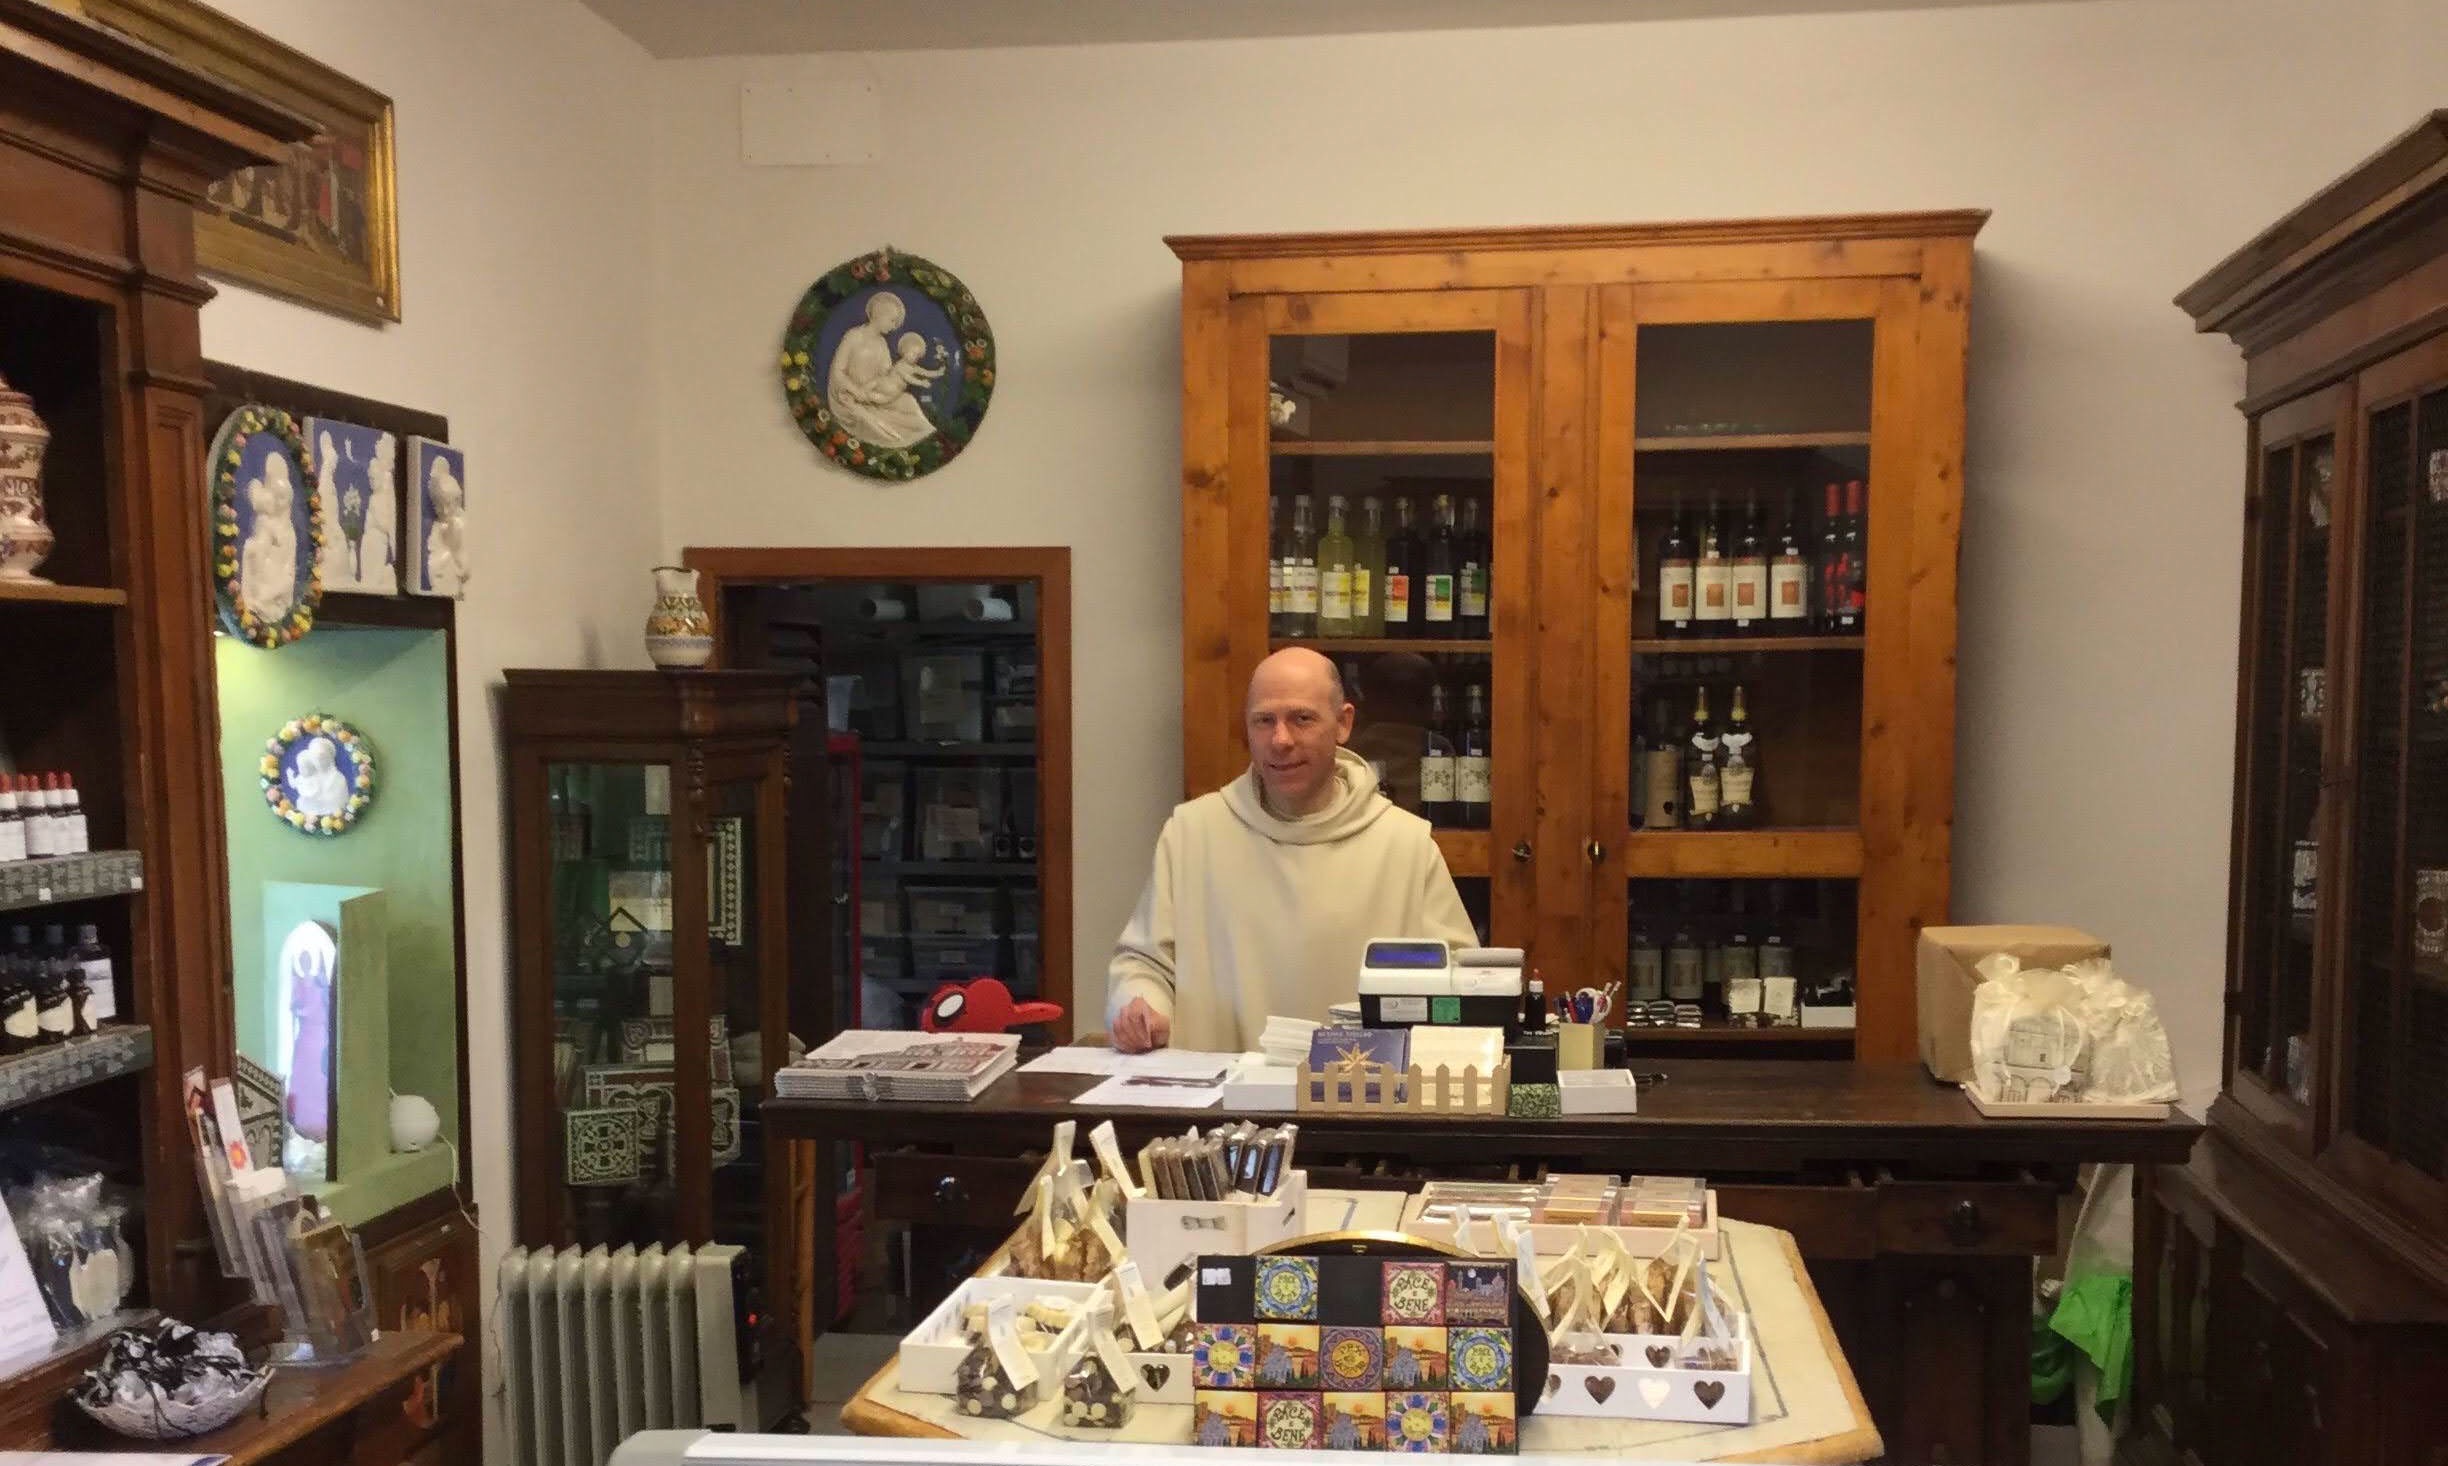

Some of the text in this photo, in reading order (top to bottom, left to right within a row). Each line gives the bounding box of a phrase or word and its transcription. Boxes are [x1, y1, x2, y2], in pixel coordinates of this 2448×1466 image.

[1396, 1275, 1430, 1291] PACE
[1394, 1296, 1430, 1312] BENE
[1273, 1404, 1305, 1422] PACE
[1271, 1427, 1305, 1443] BENE
